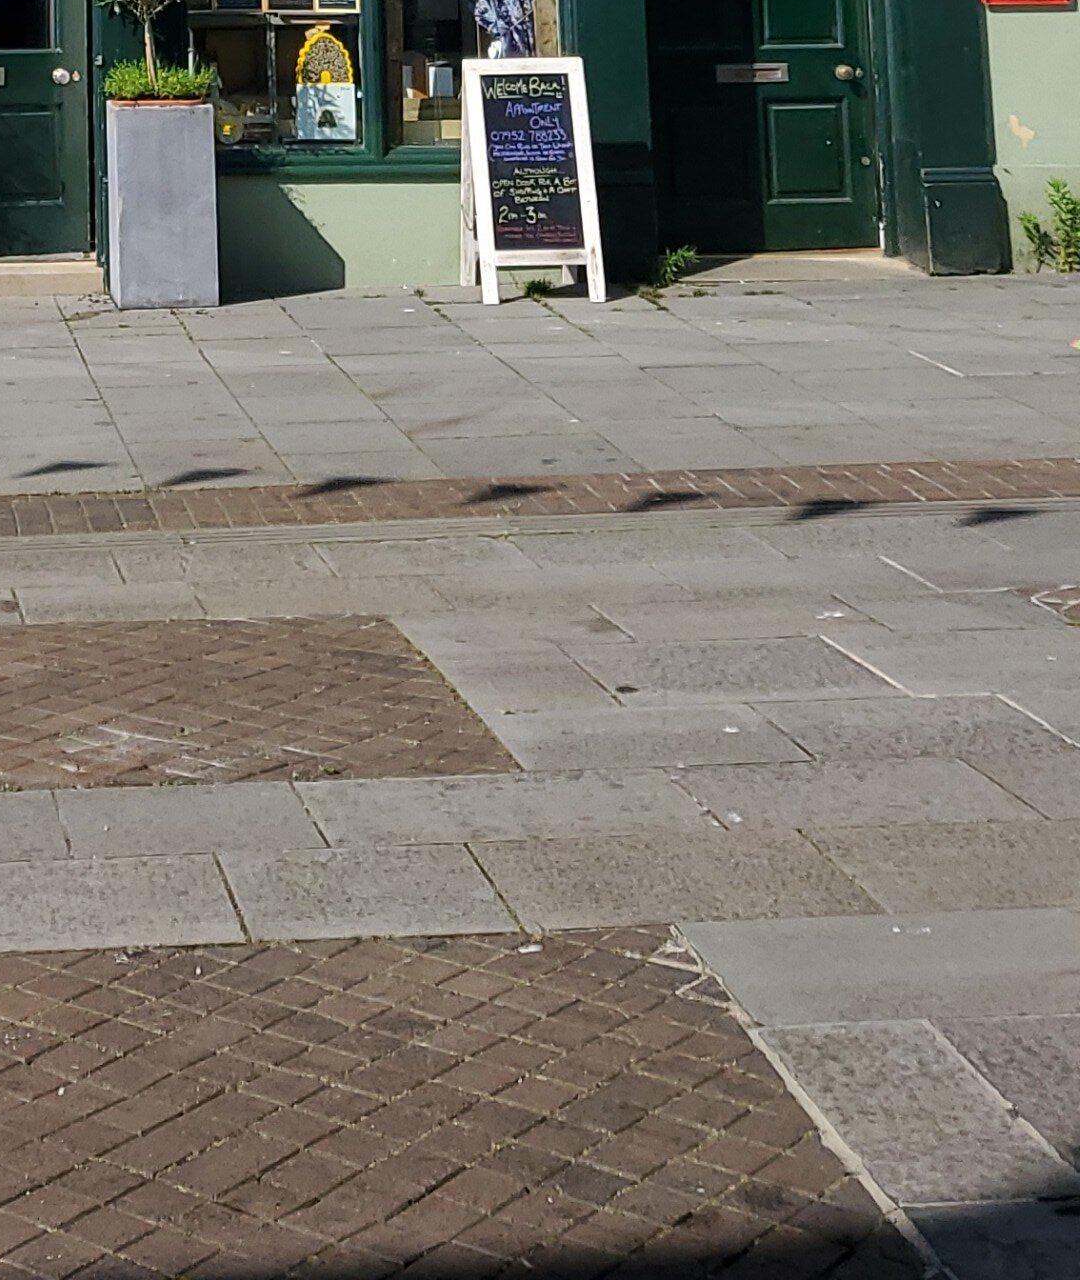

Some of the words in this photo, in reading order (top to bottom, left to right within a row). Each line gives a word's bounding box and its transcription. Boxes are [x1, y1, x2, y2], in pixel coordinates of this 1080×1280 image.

[482, 77, 528, 99] WELCOME
[530, 115, 559, 130] ONLY
[553, 178, 561, 187] A
